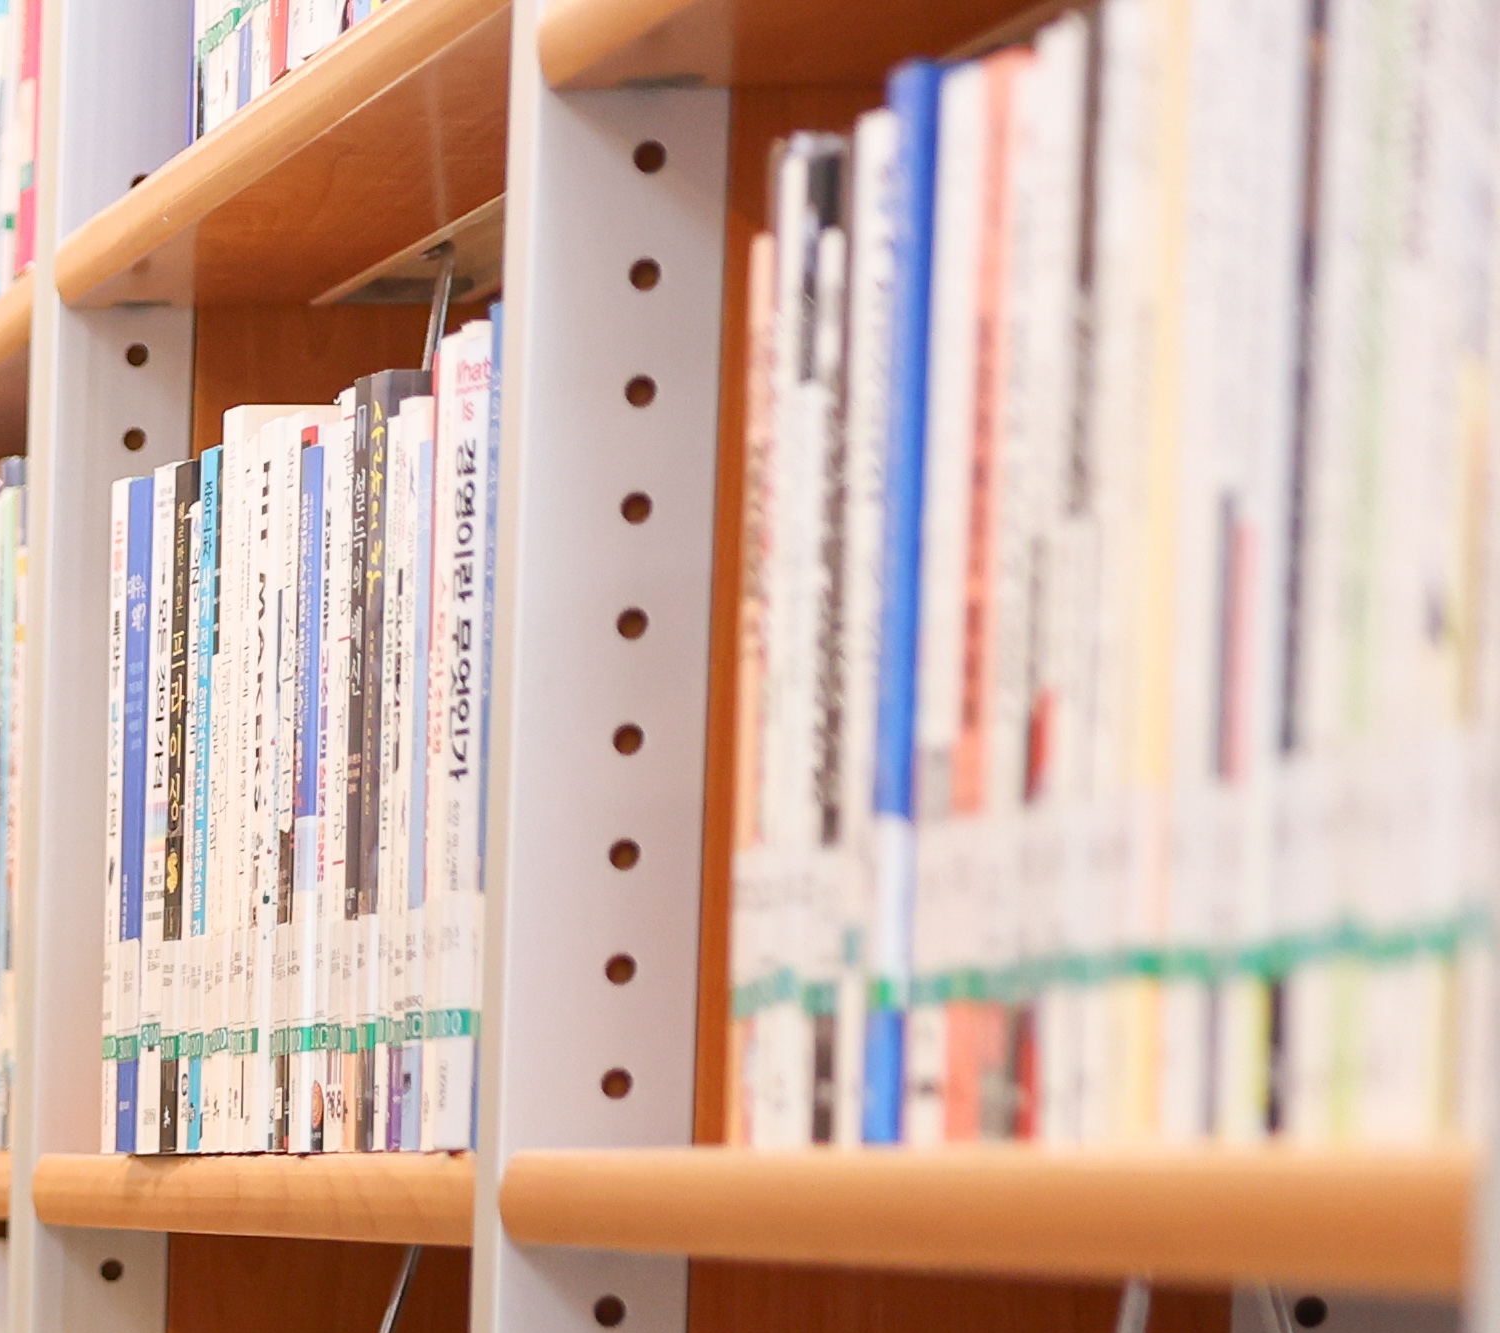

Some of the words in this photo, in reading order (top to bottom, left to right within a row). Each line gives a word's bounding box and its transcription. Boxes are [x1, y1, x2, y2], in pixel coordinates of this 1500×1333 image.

[453, 438, 478, 601] 경영이란
[169, 631, 186, 820] 프라이싱
[254, 572, 267, 812] MAKERS
[449, 616, 473, 780] 무엇인가
